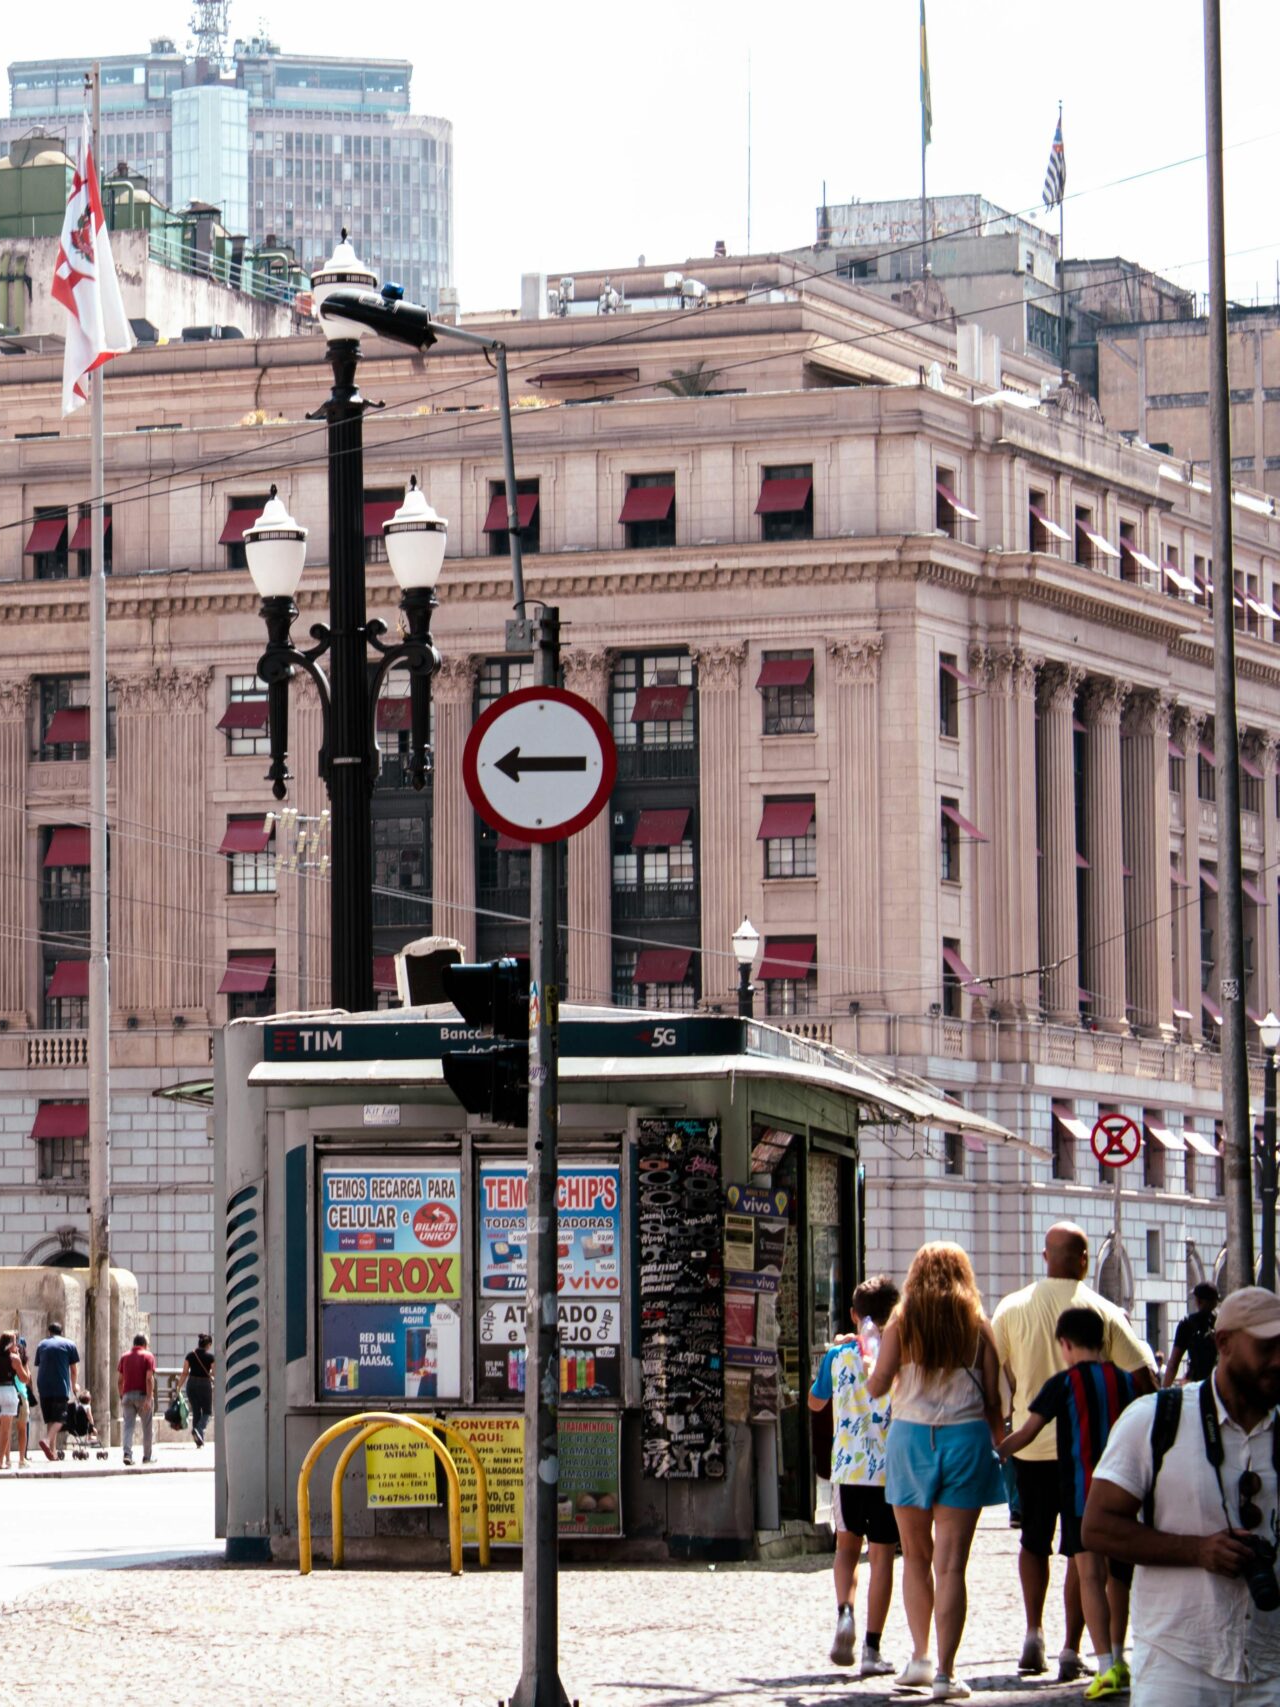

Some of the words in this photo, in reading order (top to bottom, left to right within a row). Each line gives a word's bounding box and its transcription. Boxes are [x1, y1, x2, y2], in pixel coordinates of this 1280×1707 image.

[299, 1030, 343, 1051] TIM
[651, 1027, 676, 1047] 5G
[328, 1179, 366, 1199] TEMOS
[371, 1179, 422, 1199] RECARGA
[428, 1179, 456, 1199] PARA
[484, 1178, 528, 1209] TEM
[743, 1197, 771, 1213] vivo
[328, 1206, 397, 1228] CELULAR
[403, 1211, 410, 1224] e
[415, 1222, 457, 1232] BILHETE
[486, 1218, 525, 1229] TODAS
[328, 1257, 454, 1294] XEROX
[569, 1270, 619, 1290] vivo
[756, 1276, 775, 1288] vivo
[400, 1306, 427, 1315] GELADO
[504, 1306, 597, 1322] ATADO
[481, 1310, 496, 1341] CHIP
[597, 1308, 614, 1340] CHIP
[360, 1333, 375, 1343] RED
[377, 1333, 395, 1343] BULL
[508, 1330, 518, 1341] e
[360, 1345, 368, 1354] TE
[360, 1357, 393, 1366] AAASAS.
[754, 1352, 773, 1364] vivo
[452, 1420, 520, 1430] CONVERTA
[469, 1433, 504, 1442] AQUI:
[367, 1443, 399, 1451] MOEDAS
[503, 1492, 516, 1501] CD
